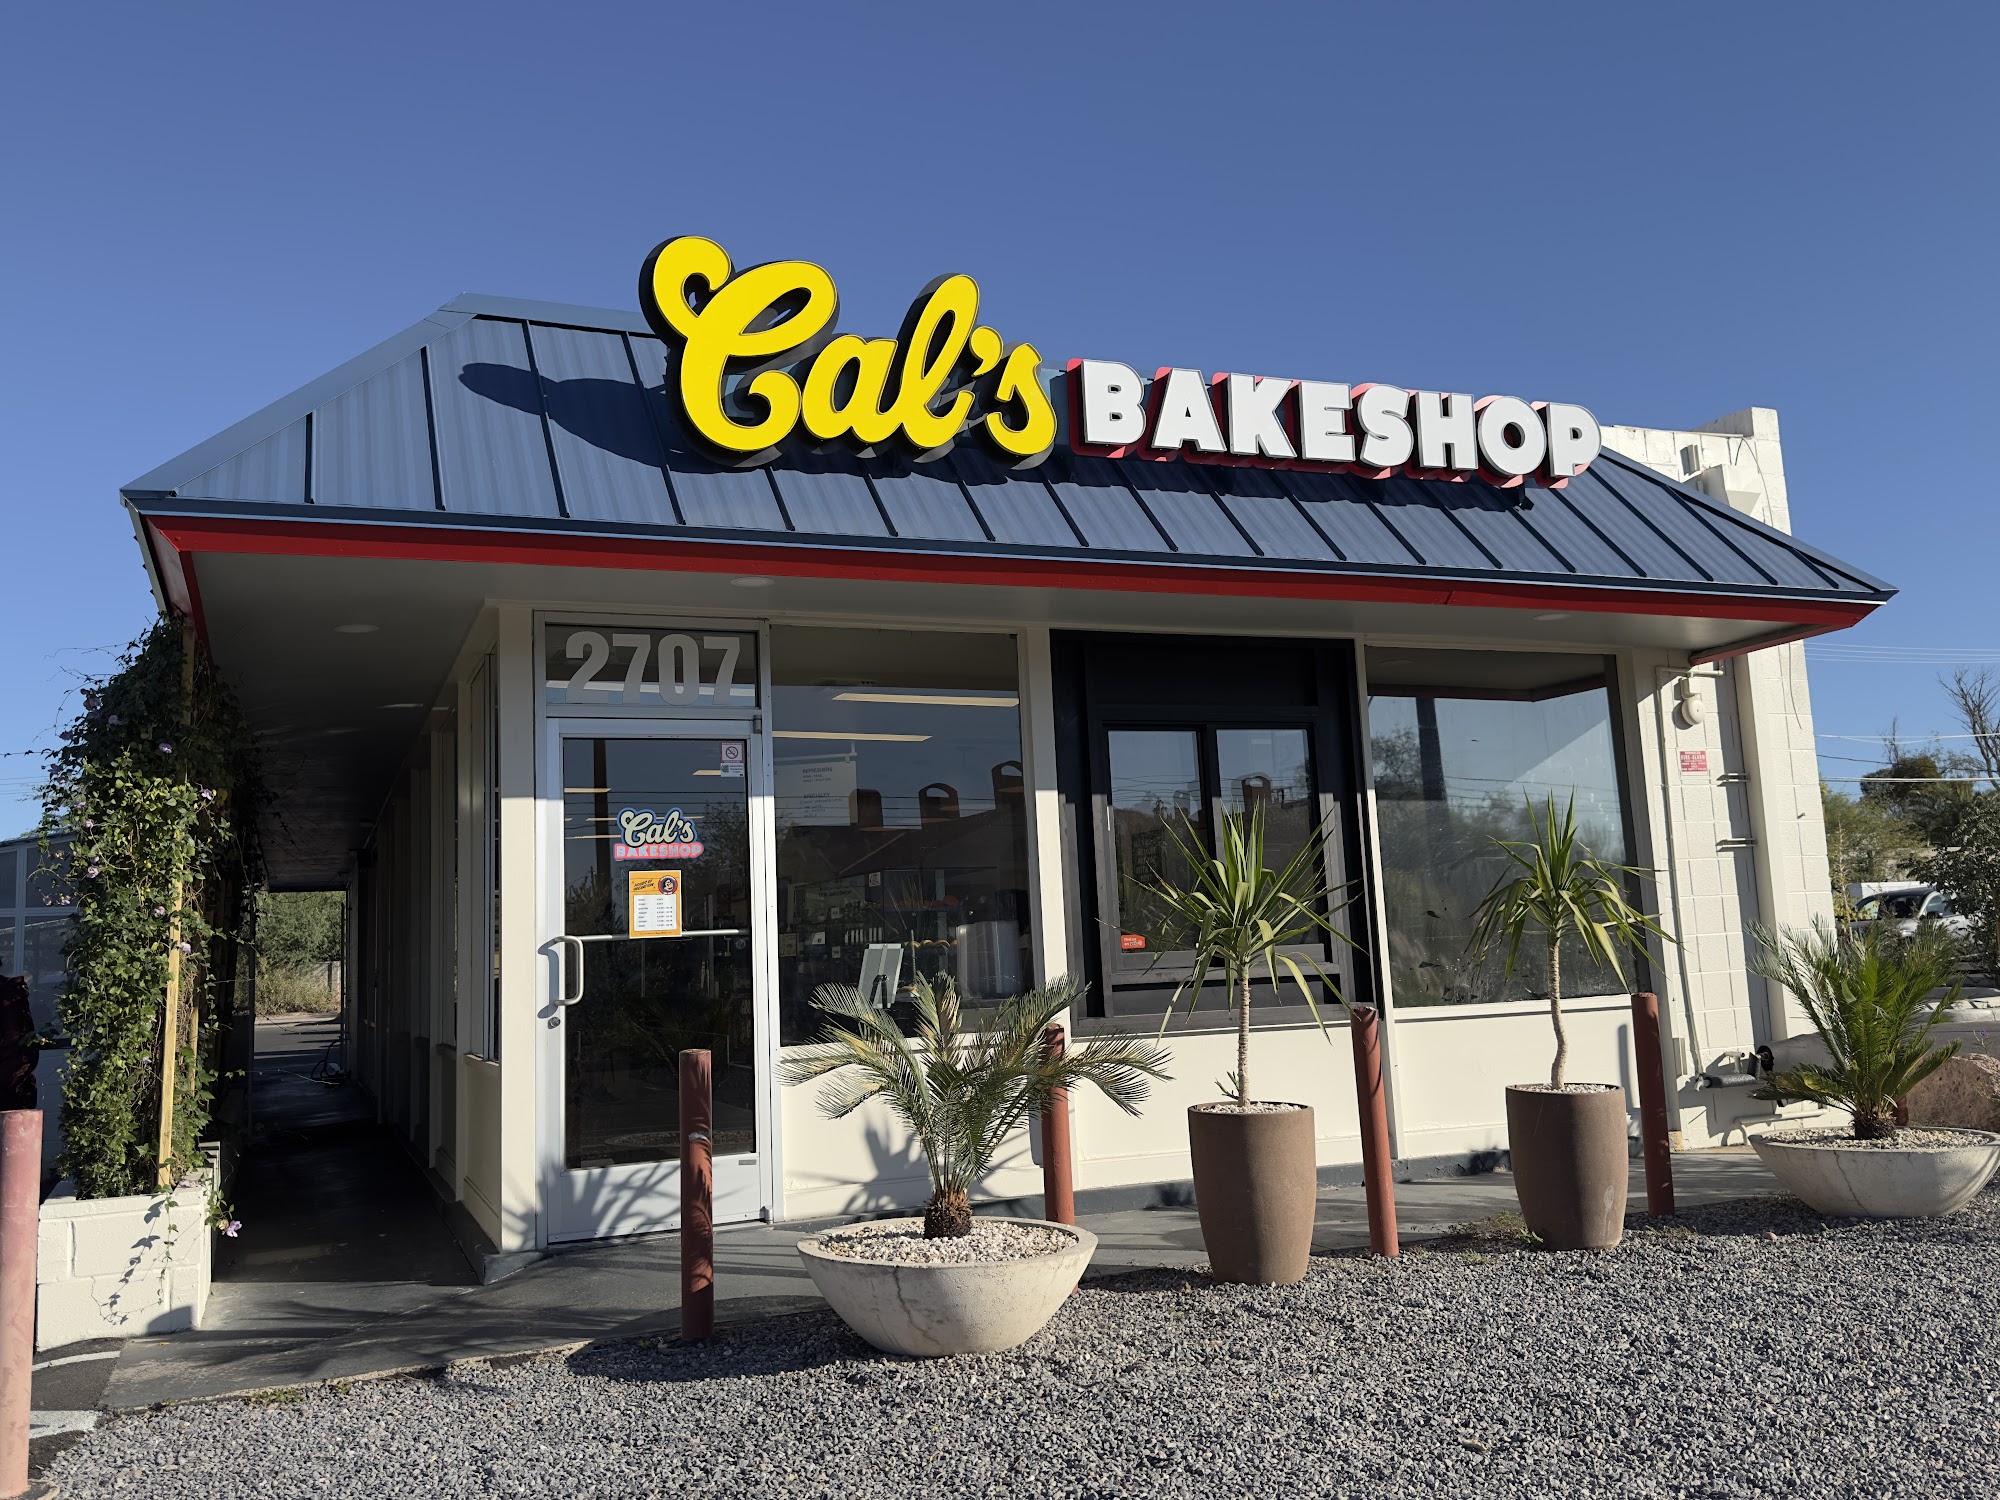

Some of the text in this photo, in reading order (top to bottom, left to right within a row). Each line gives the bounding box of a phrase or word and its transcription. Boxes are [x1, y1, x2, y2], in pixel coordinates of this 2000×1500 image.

[648, 235, 1057, 460] Cal's
[1080, 358, 1603, 482] BAKESHOP
[565, 630, 741, 706] 2707
[616, 844, 703, 858] BAKESHOP
[620, 809, 695, 848] Cal's
